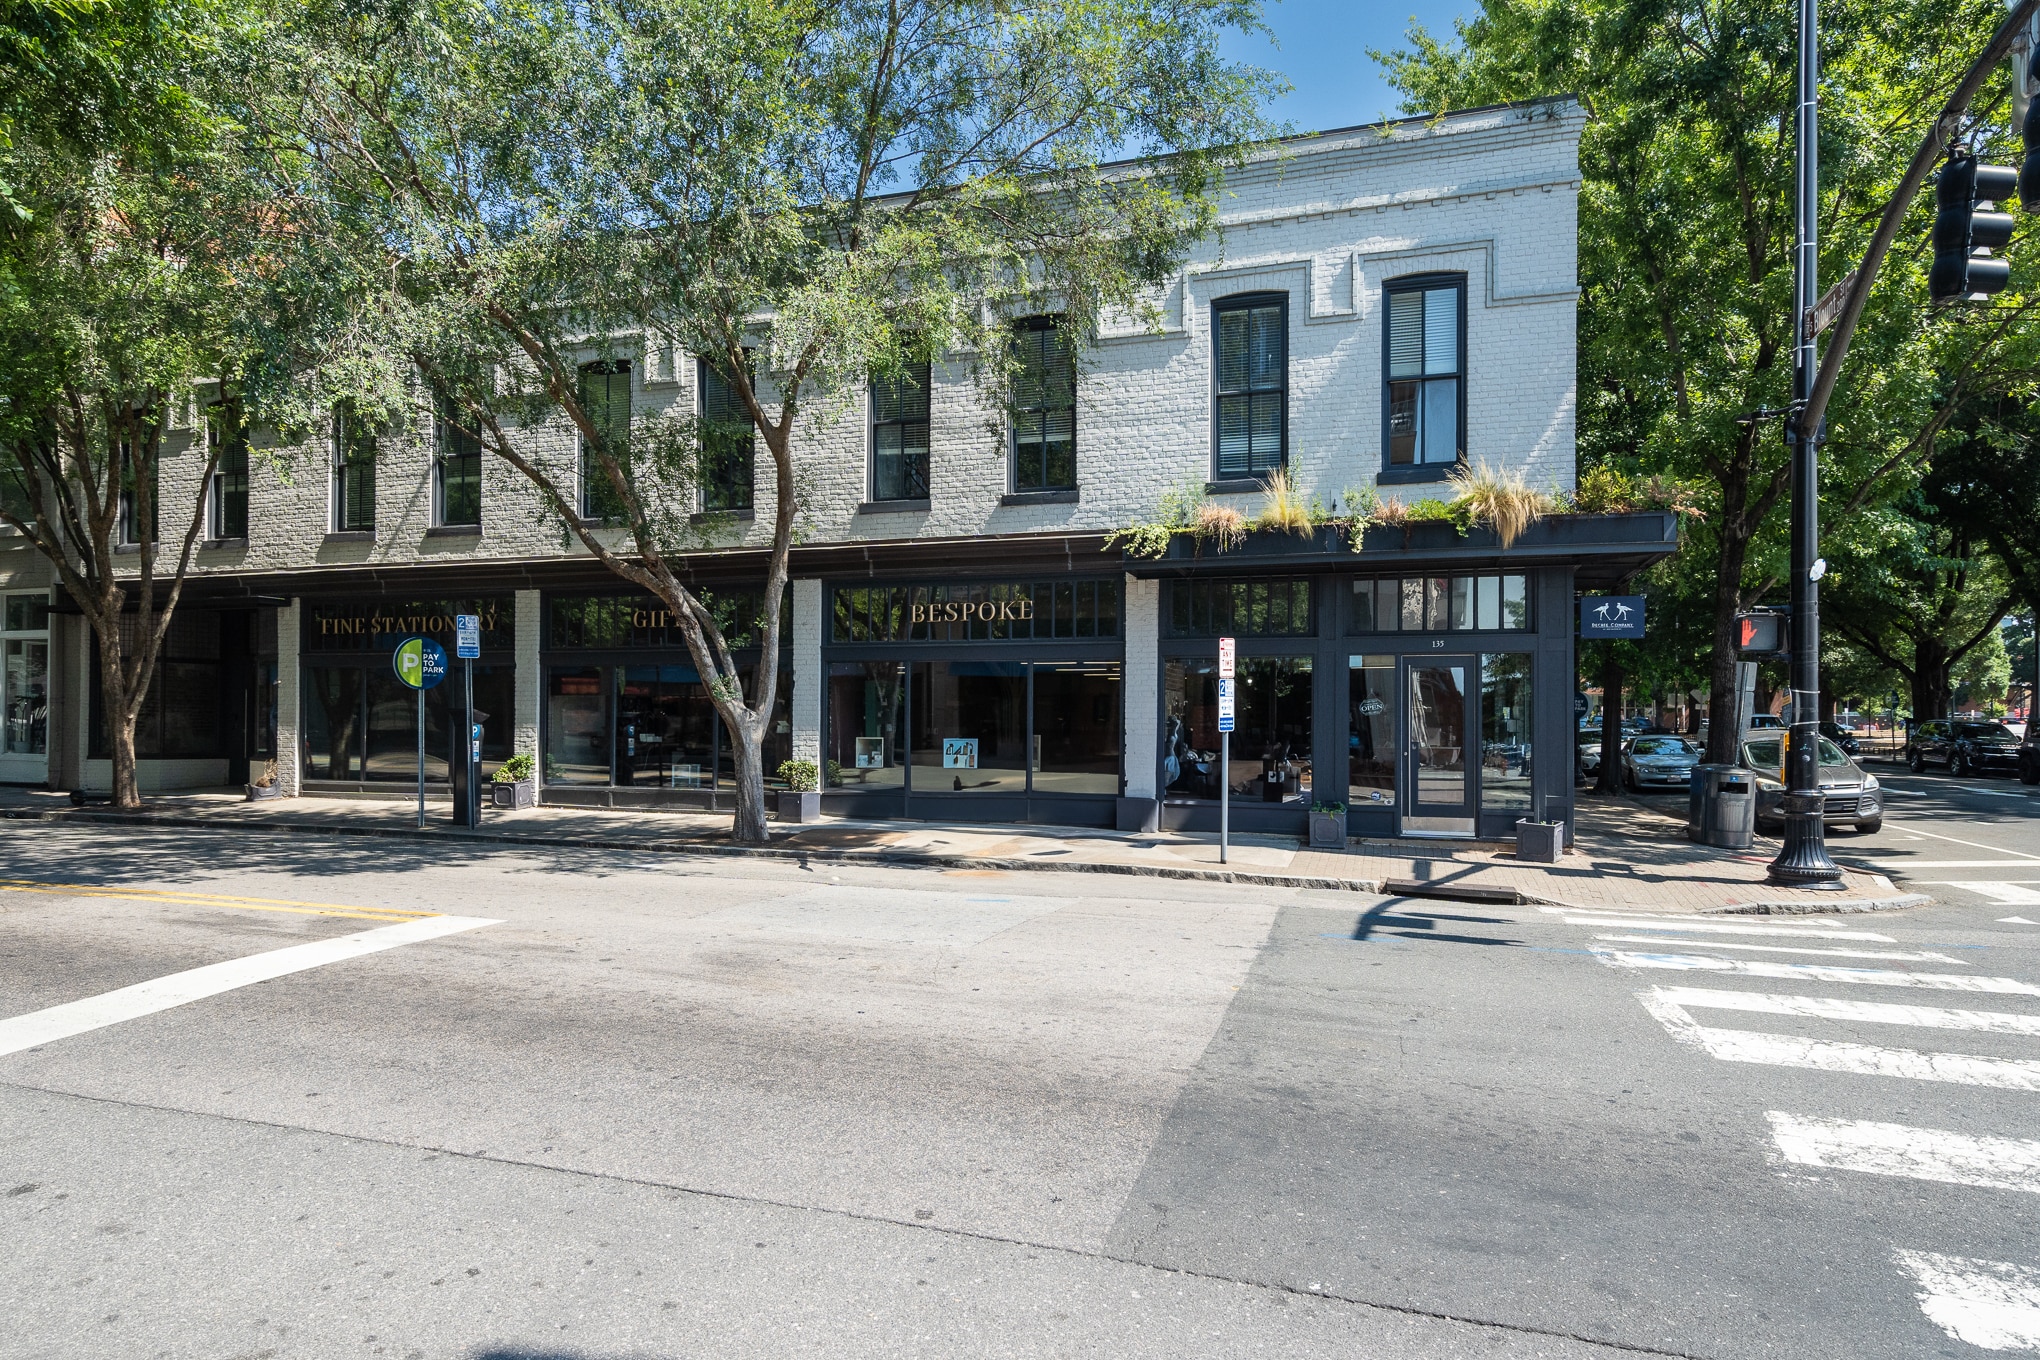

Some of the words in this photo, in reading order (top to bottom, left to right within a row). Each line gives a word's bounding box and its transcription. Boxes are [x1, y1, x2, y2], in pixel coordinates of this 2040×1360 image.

[1814, 293, 1836, 333] Blount
[910, 600, 1033, 623] BESPOKE
[321, 617, 365, 635] FINE
[458, 617, 465, 628] 2
[1432, 640, 1445, 648] 135
[402, 652, 419, 673] P
[422, 653, 439, 661] PAY
[422, 666, 444, 674] PARK
[1220, 682, 1225, 694] 2
